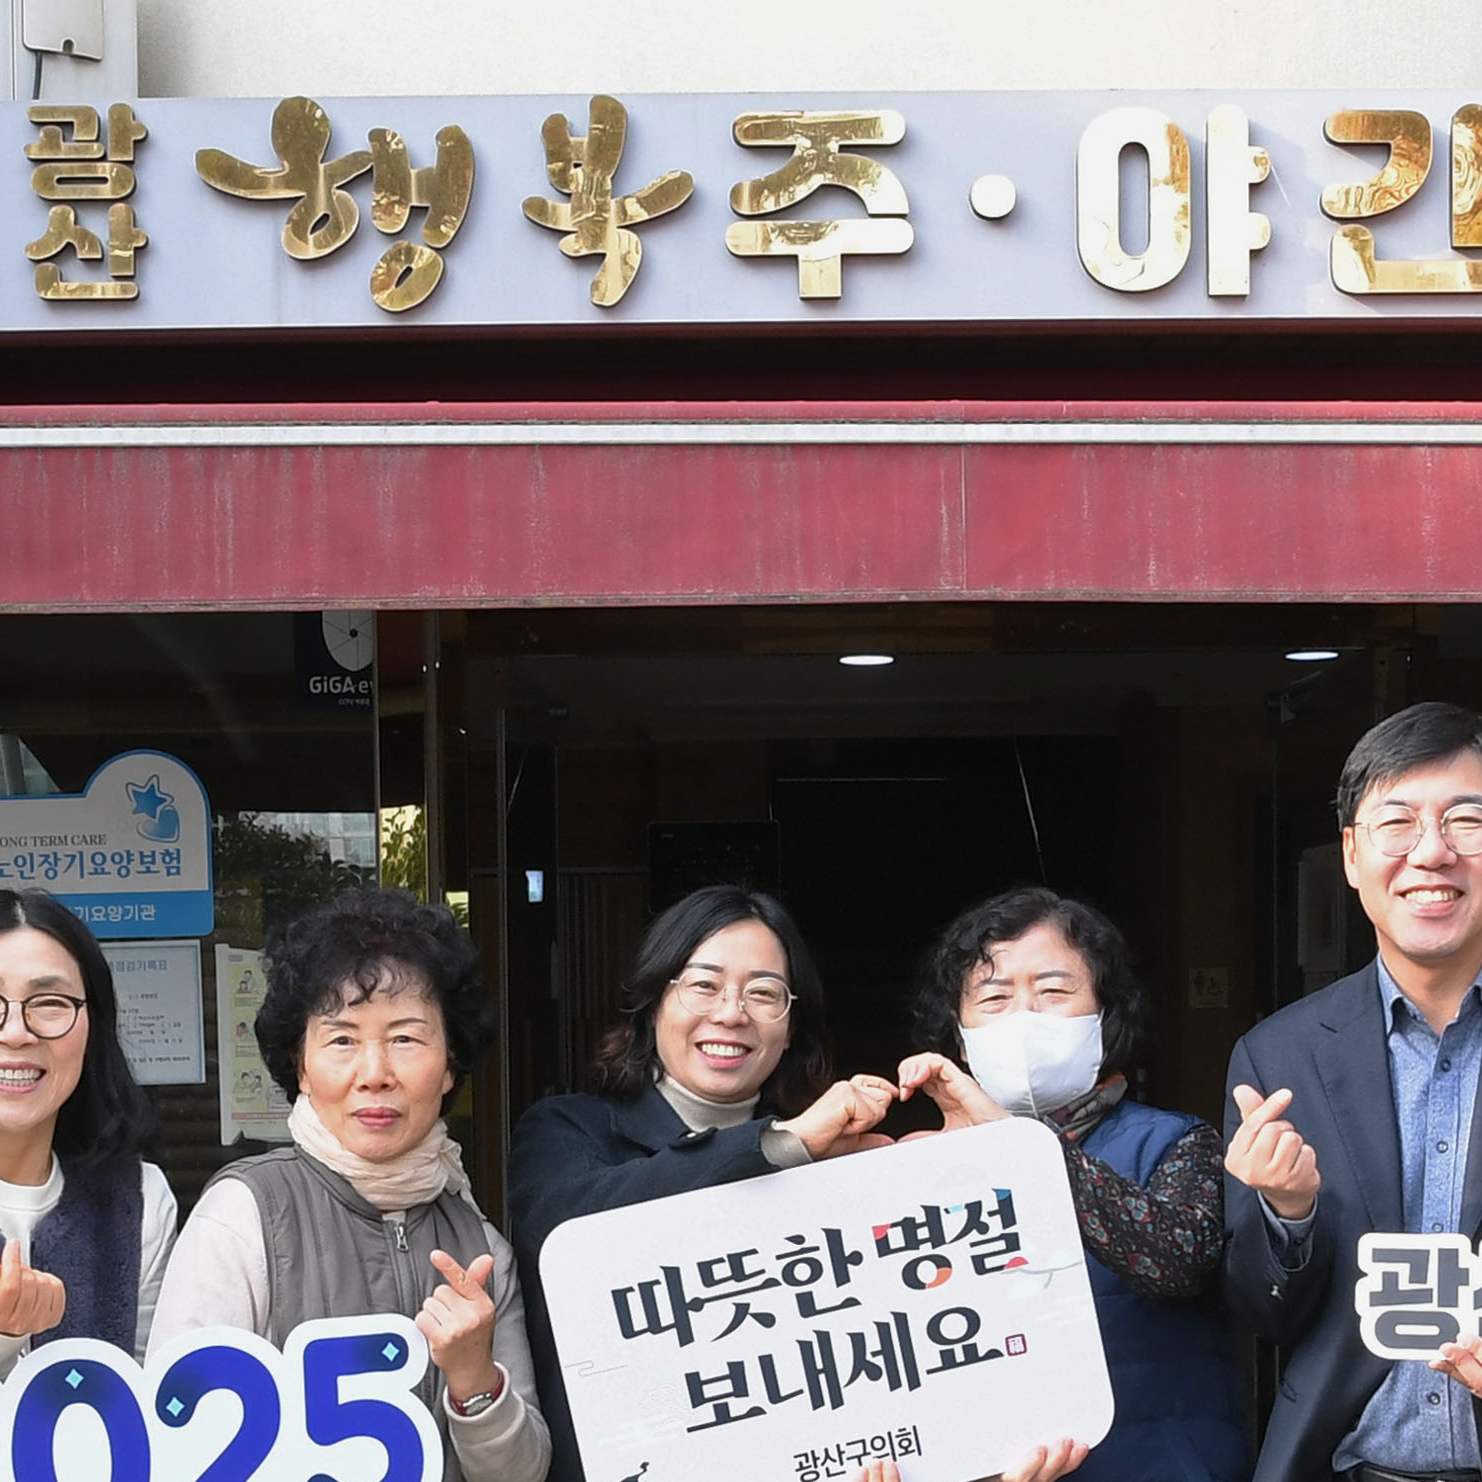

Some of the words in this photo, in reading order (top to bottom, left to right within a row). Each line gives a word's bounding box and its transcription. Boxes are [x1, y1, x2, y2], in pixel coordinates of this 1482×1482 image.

[24, 102, 148, 301] 광산
[309, 676, 355, 694] GiGA
[32, 835, 68, 847] TERM
[71, 834, 107, 846] CARE
[69, 904, 156, 922] 기요양기관
[610, 1228, 864, 1347] 따뜻한
[684, 1305, 1005, 1434] 보내세요
